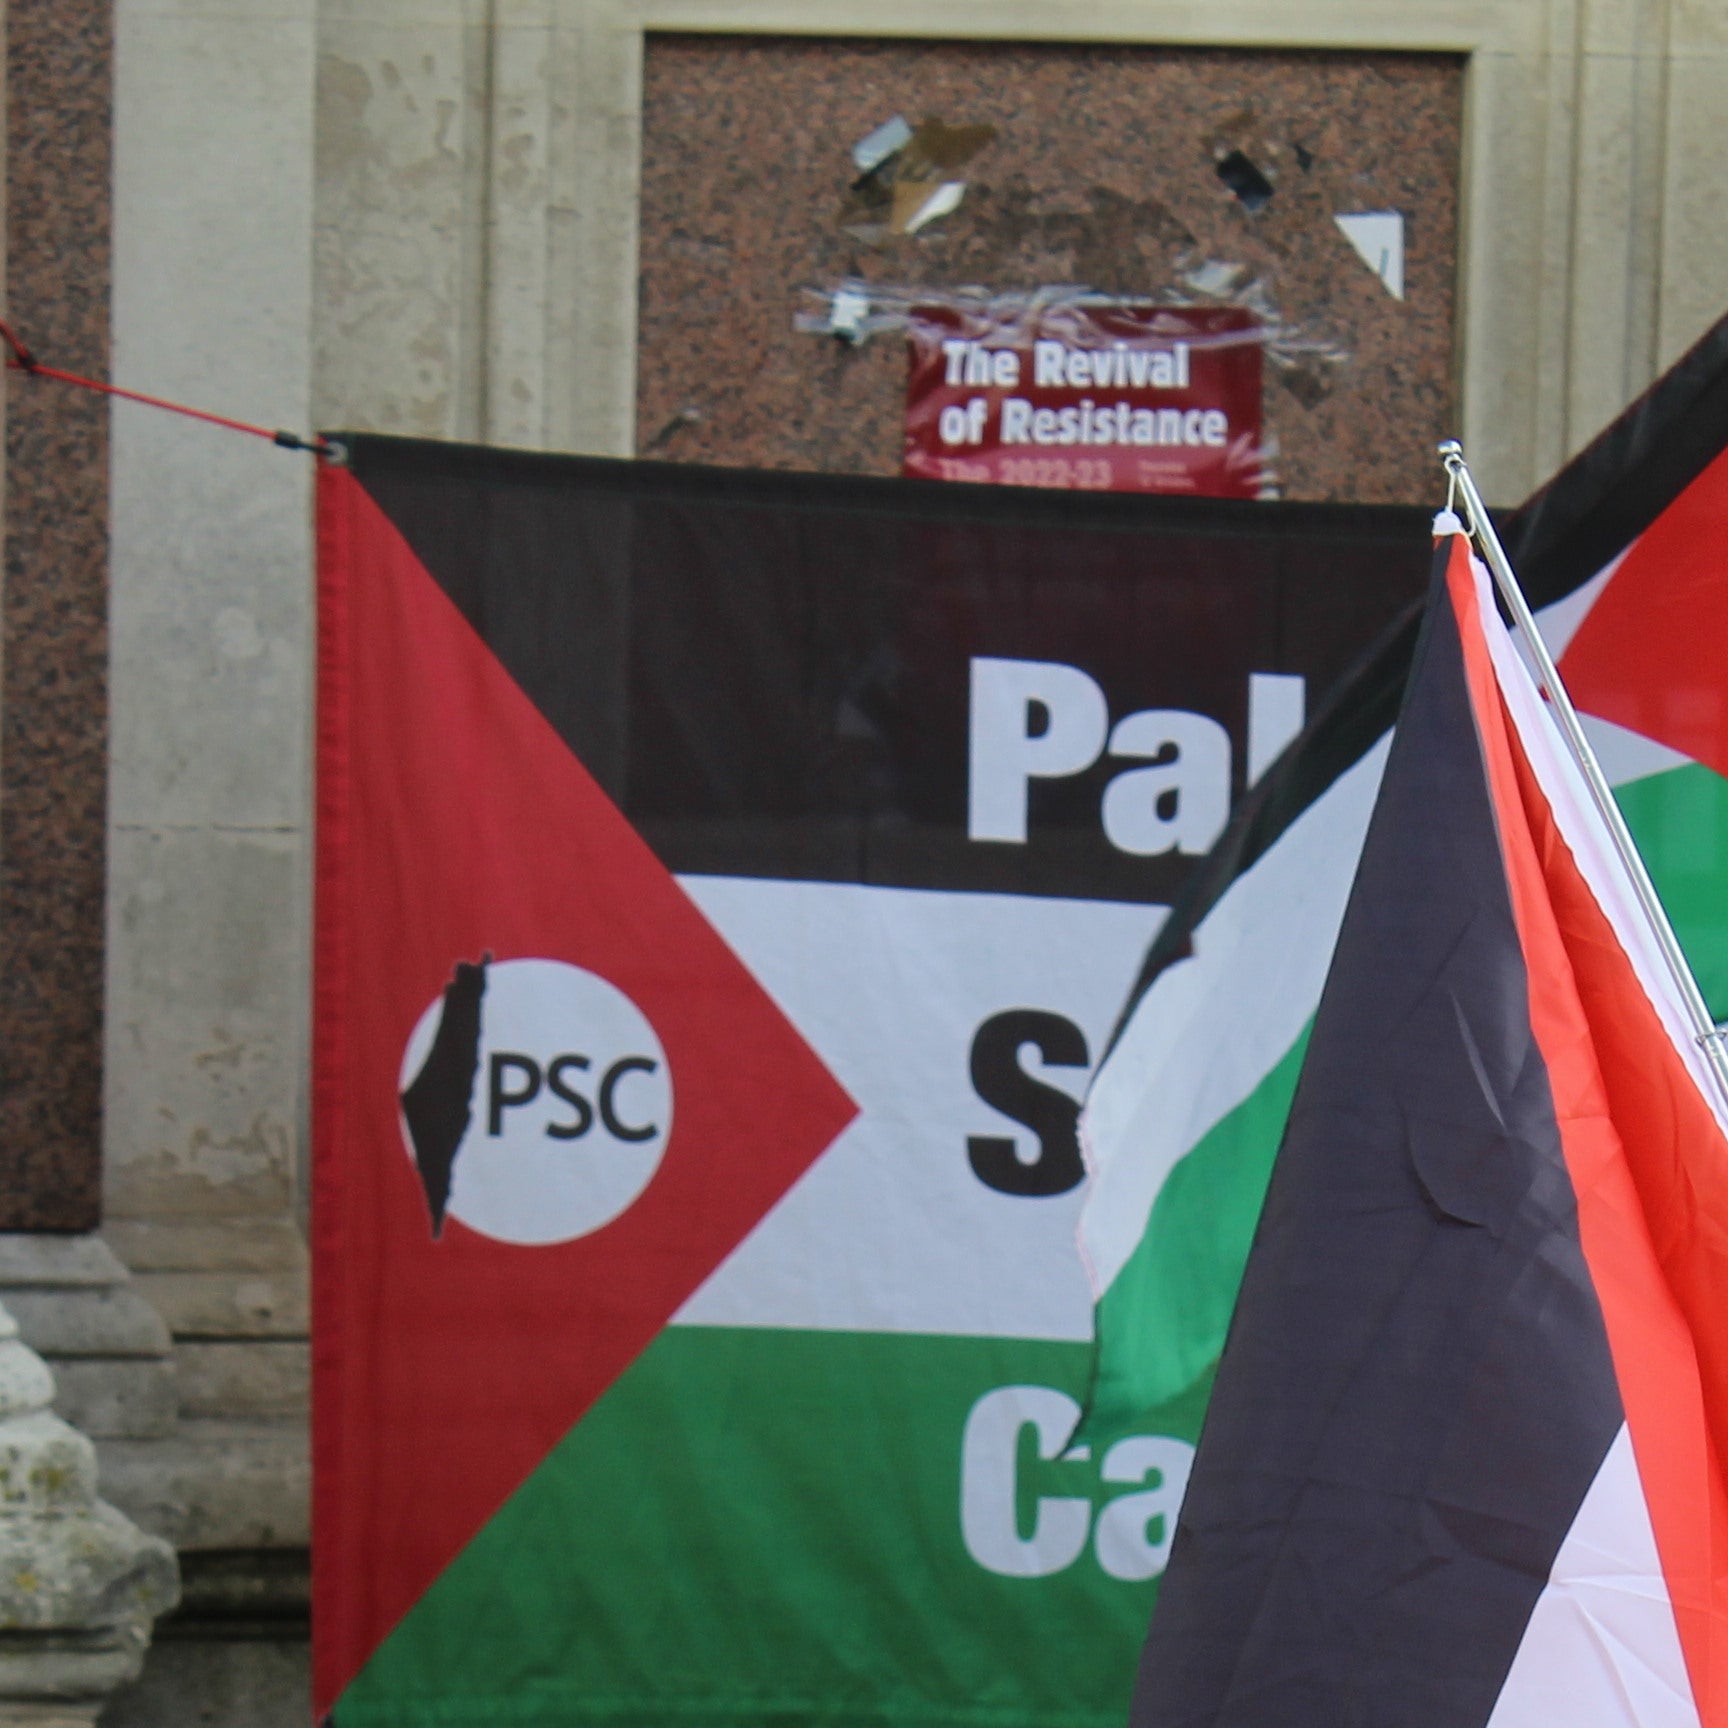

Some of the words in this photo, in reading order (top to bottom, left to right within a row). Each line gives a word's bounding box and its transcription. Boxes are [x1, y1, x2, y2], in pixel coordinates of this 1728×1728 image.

[941, 338, 1021, 387] The
[1033, 339, 1191, 389] Revival
[938, 397, 989, 446] of
[1000, 397, 1229, 447] Resistance
[486, 1051, 659, 1143] PSC
